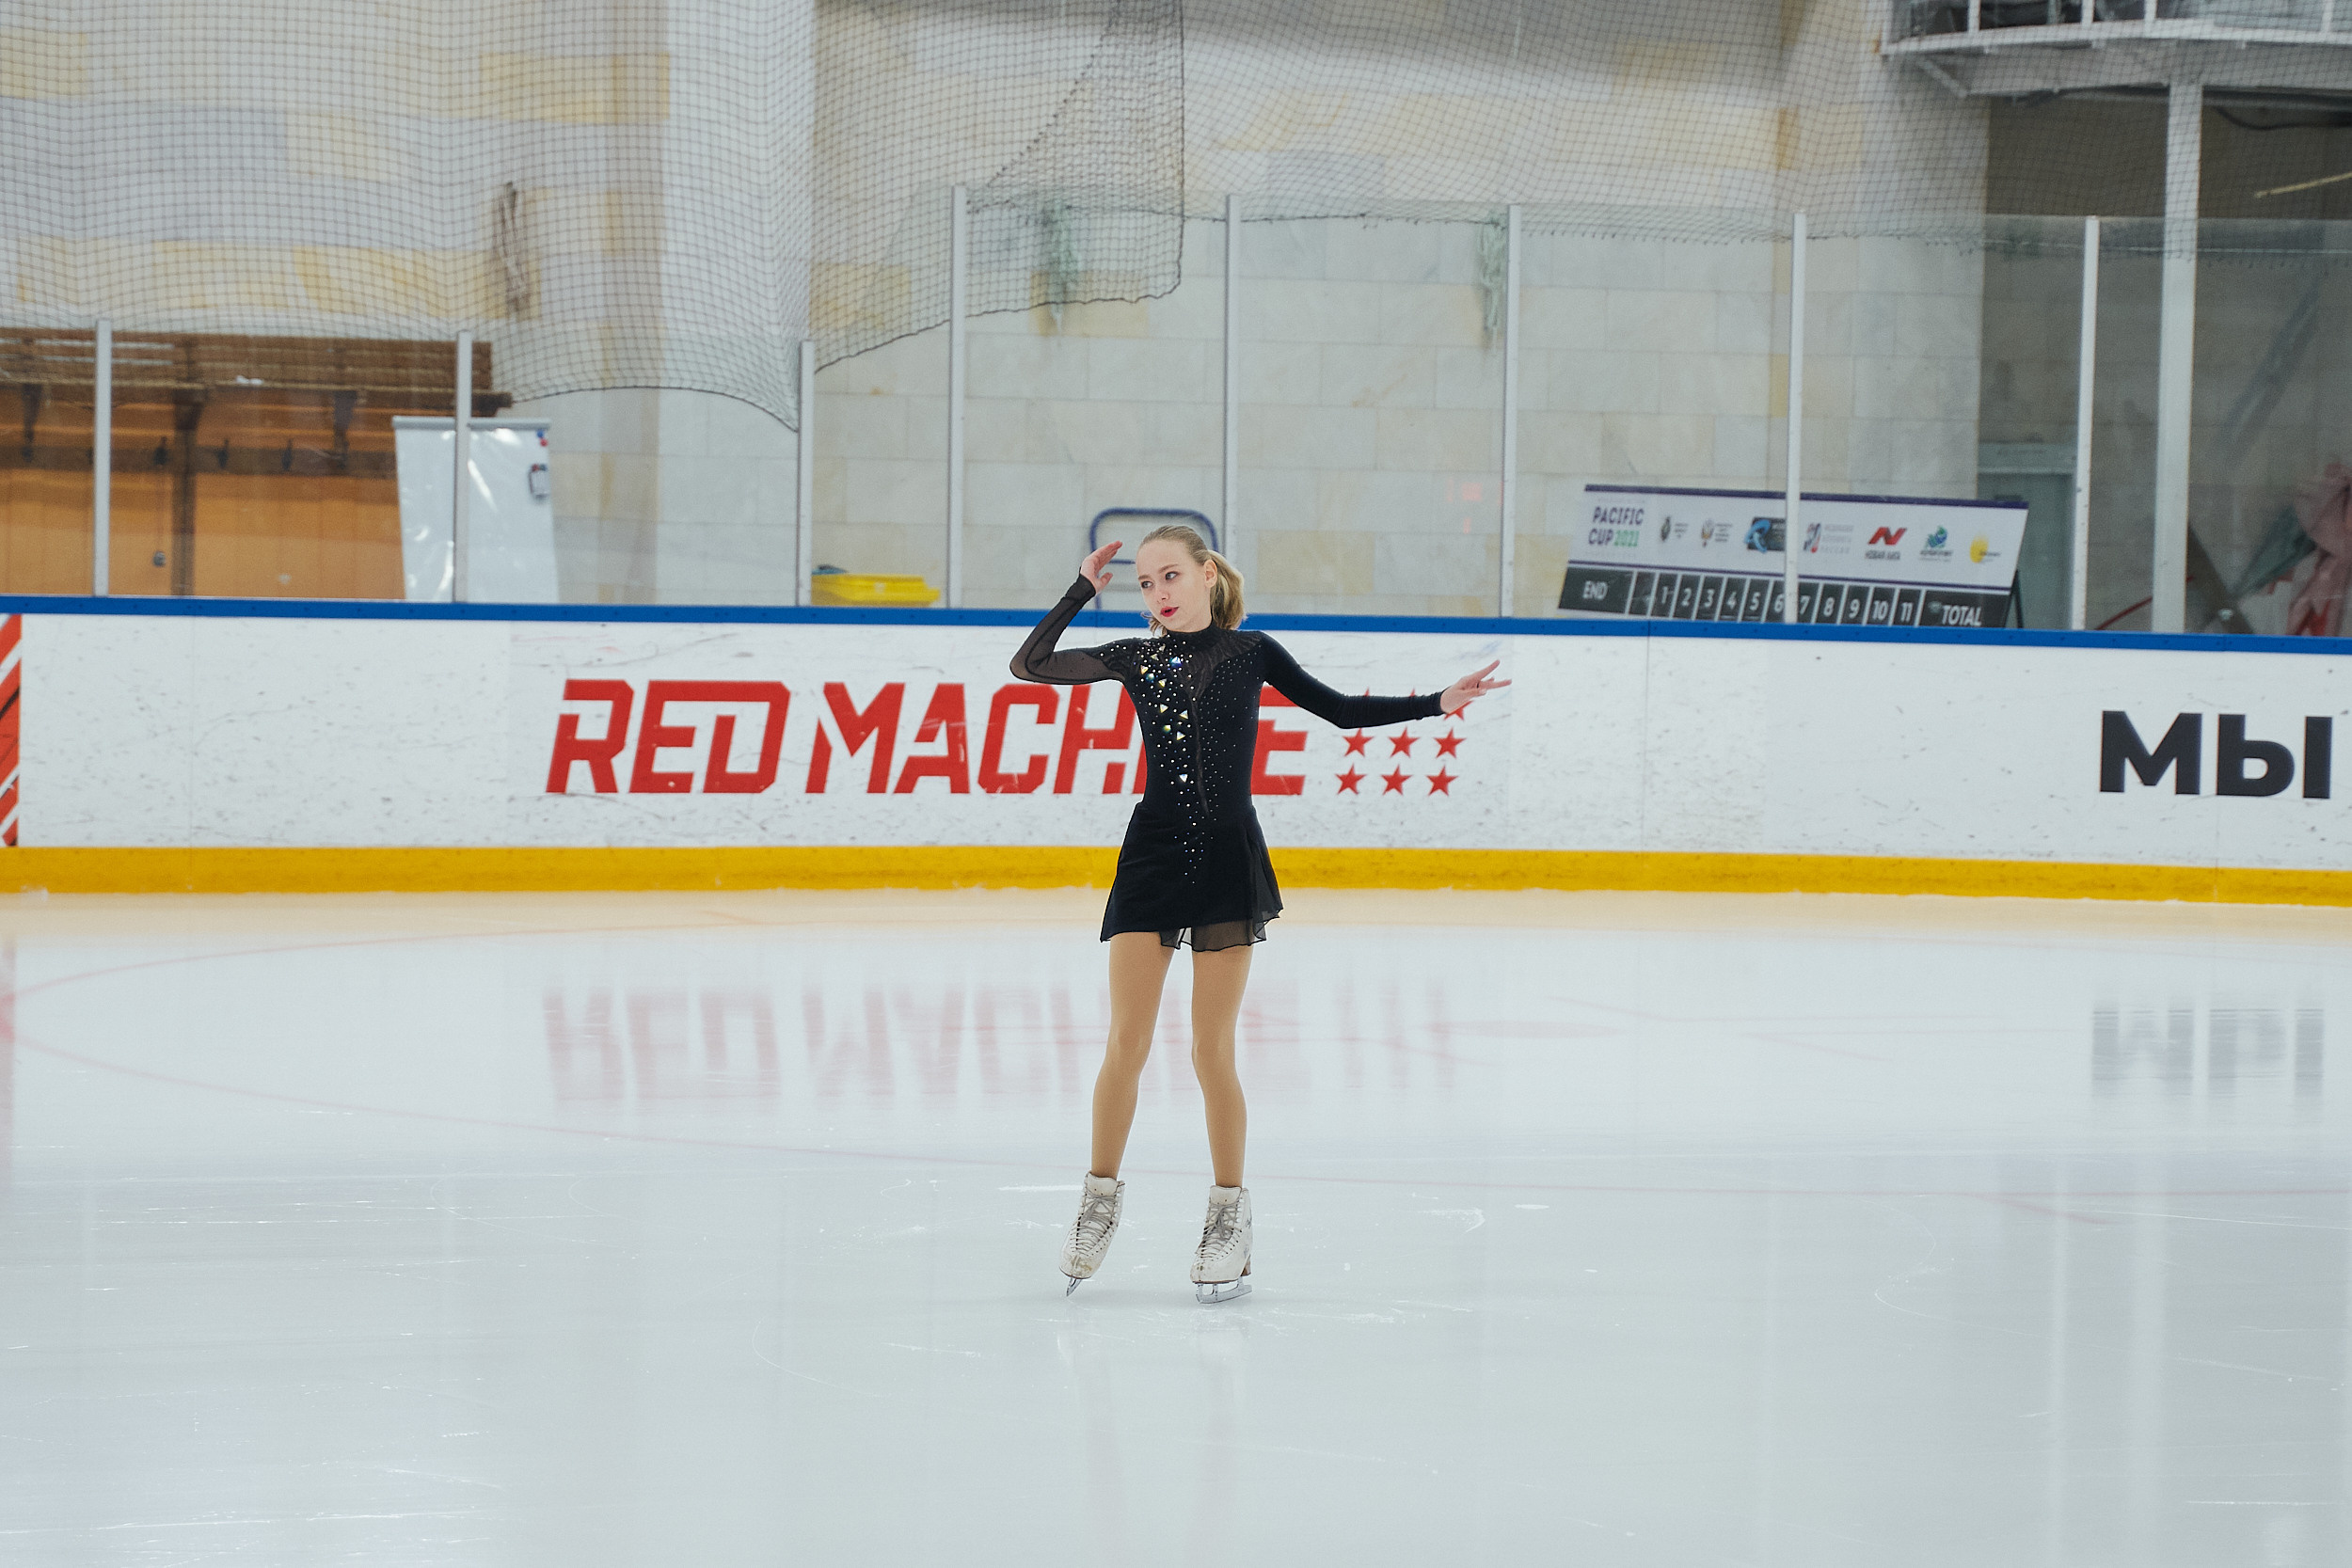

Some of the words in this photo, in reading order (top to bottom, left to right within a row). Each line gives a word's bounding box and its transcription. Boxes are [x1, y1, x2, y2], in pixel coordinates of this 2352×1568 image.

[1588, 528, 1614, 546] CUP
[1592, 506, 1645, 527] PACIFIC
[1582, 580, 1609, 601] END
[1661, 586, 1669, 605] 1
[1681, 588, 1692, 608] 2
[1704, 589, 1715, 609] 3
[1727, 592, 1739, 610] 4
[1750, 592, 1761, 611] 5
[1774, 594, 1785, 612] 6
[1798, 595, 1811, 615] 7
[1823, 597, 1836, 617] 8
[1849, 599, 1861, 619] 9
[1873, 600, 1890, 622] 10
[1901, 602, 1915, 623] 11
[1942, 605, 1982, 627] TOTAL
[546, 678, 791, 794] RED
[804, 681, 1310, 796] MACHE
[2099, 710, 2333, 800] МЫ
